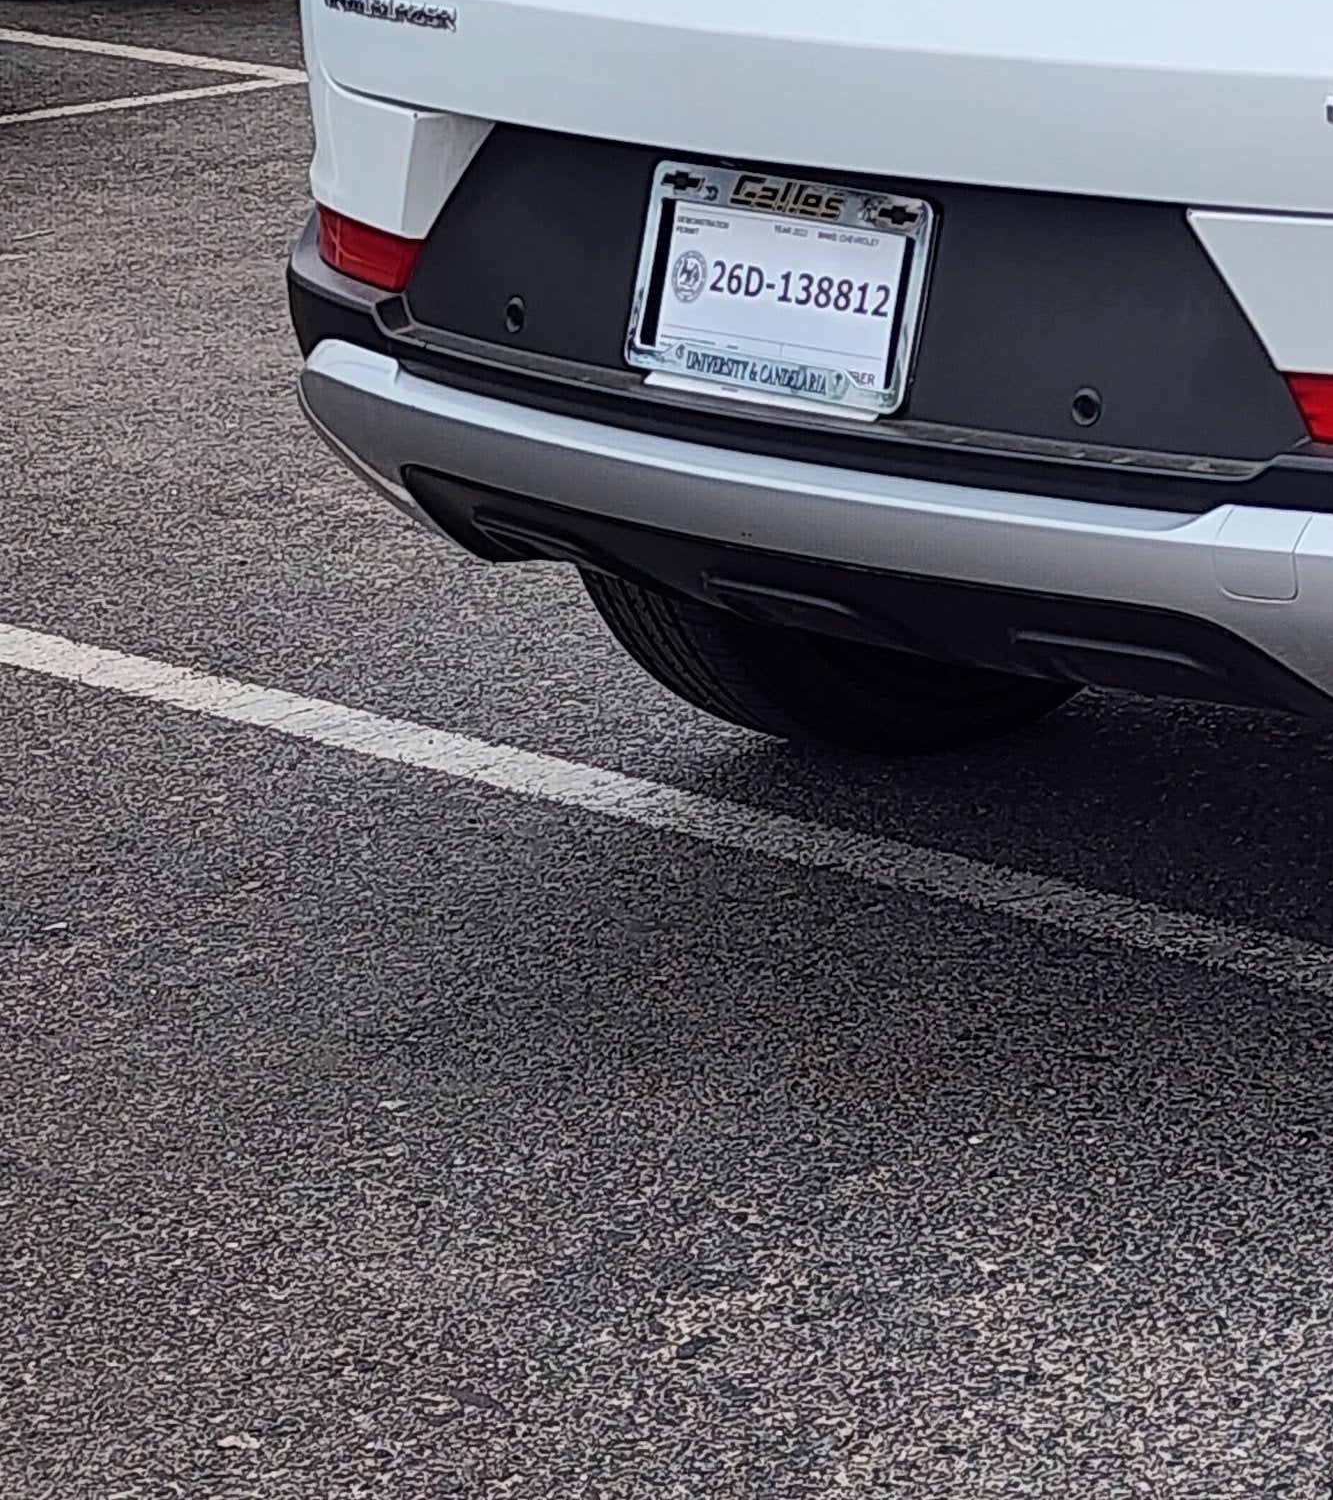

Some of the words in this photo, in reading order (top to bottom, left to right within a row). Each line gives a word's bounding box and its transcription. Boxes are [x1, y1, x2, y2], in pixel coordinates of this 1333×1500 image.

[709, 260, 891, 318] 26D-138812
[686, 350, 749, 380] UNIVERSITY
[759, 364, 827, 395] CANDELARIA
